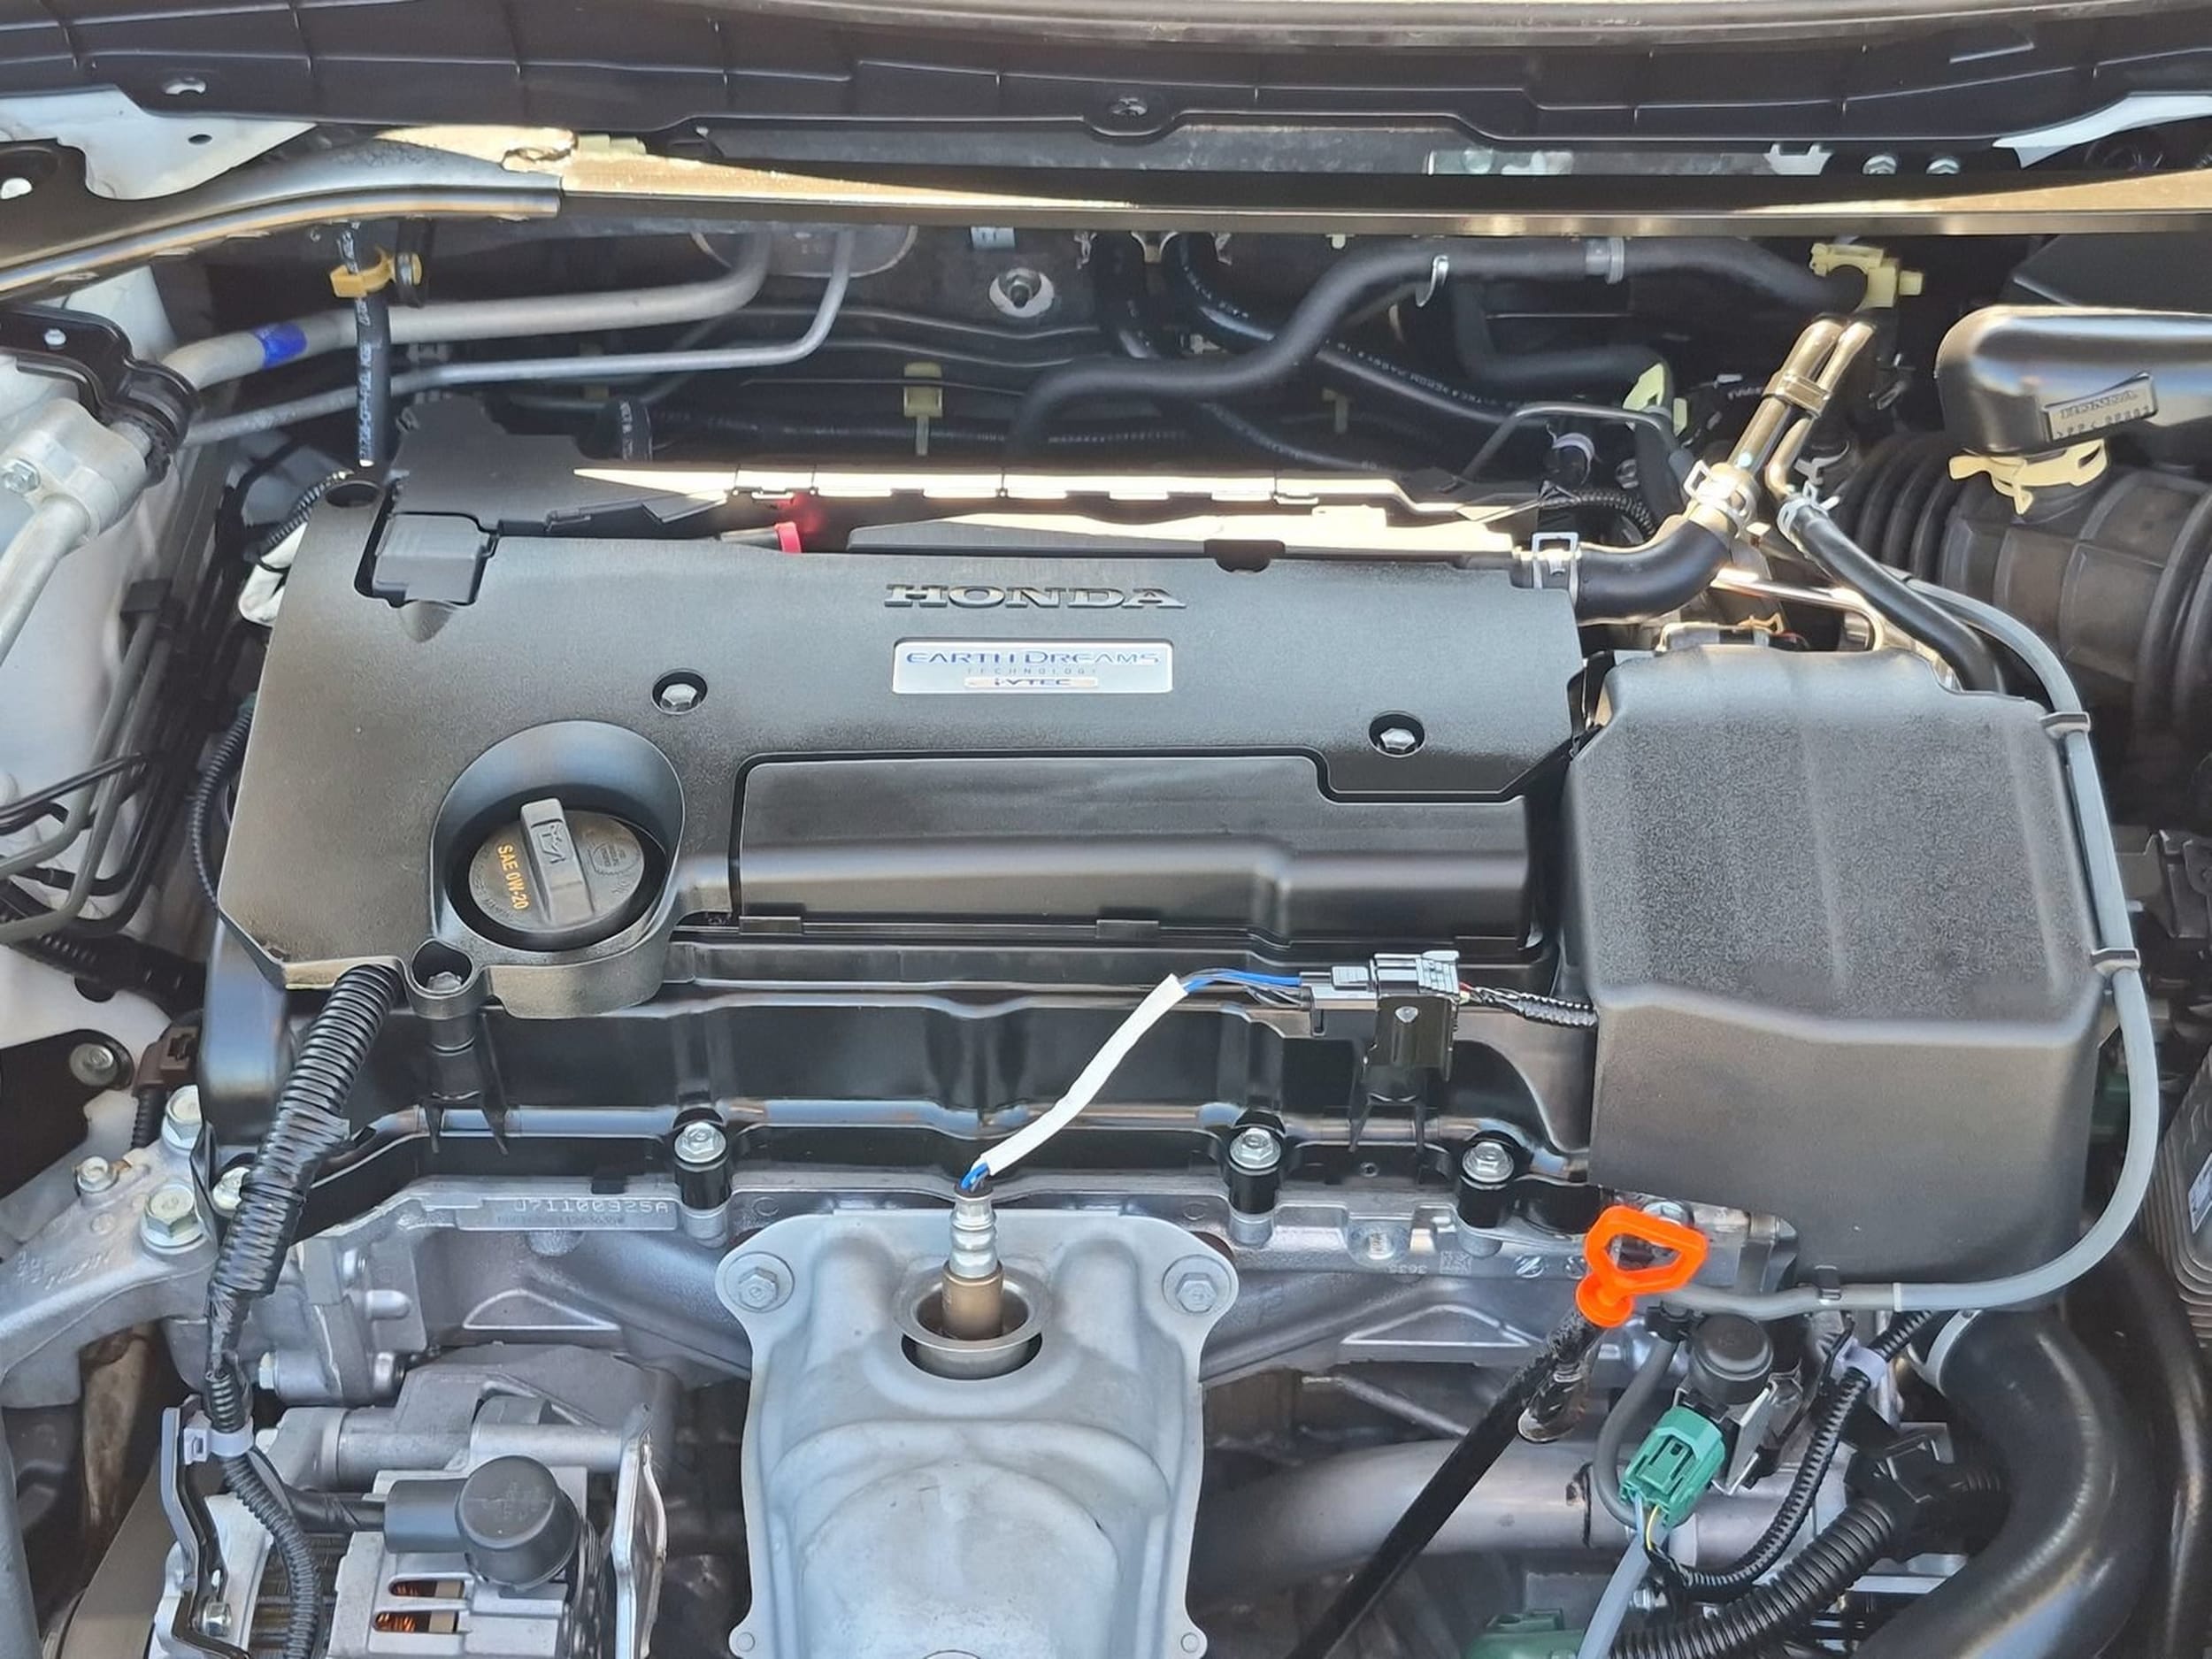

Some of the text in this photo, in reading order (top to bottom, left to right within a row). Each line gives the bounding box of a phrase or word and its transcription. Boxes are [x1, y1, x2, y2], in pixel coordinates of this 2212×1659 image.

[884, 583, 1187, 609] HONDA
[906, 652, 1015, 664] EARTH
[496, 843, 518, 872] SAE
[505, 873, 529, 910] 0W-20
